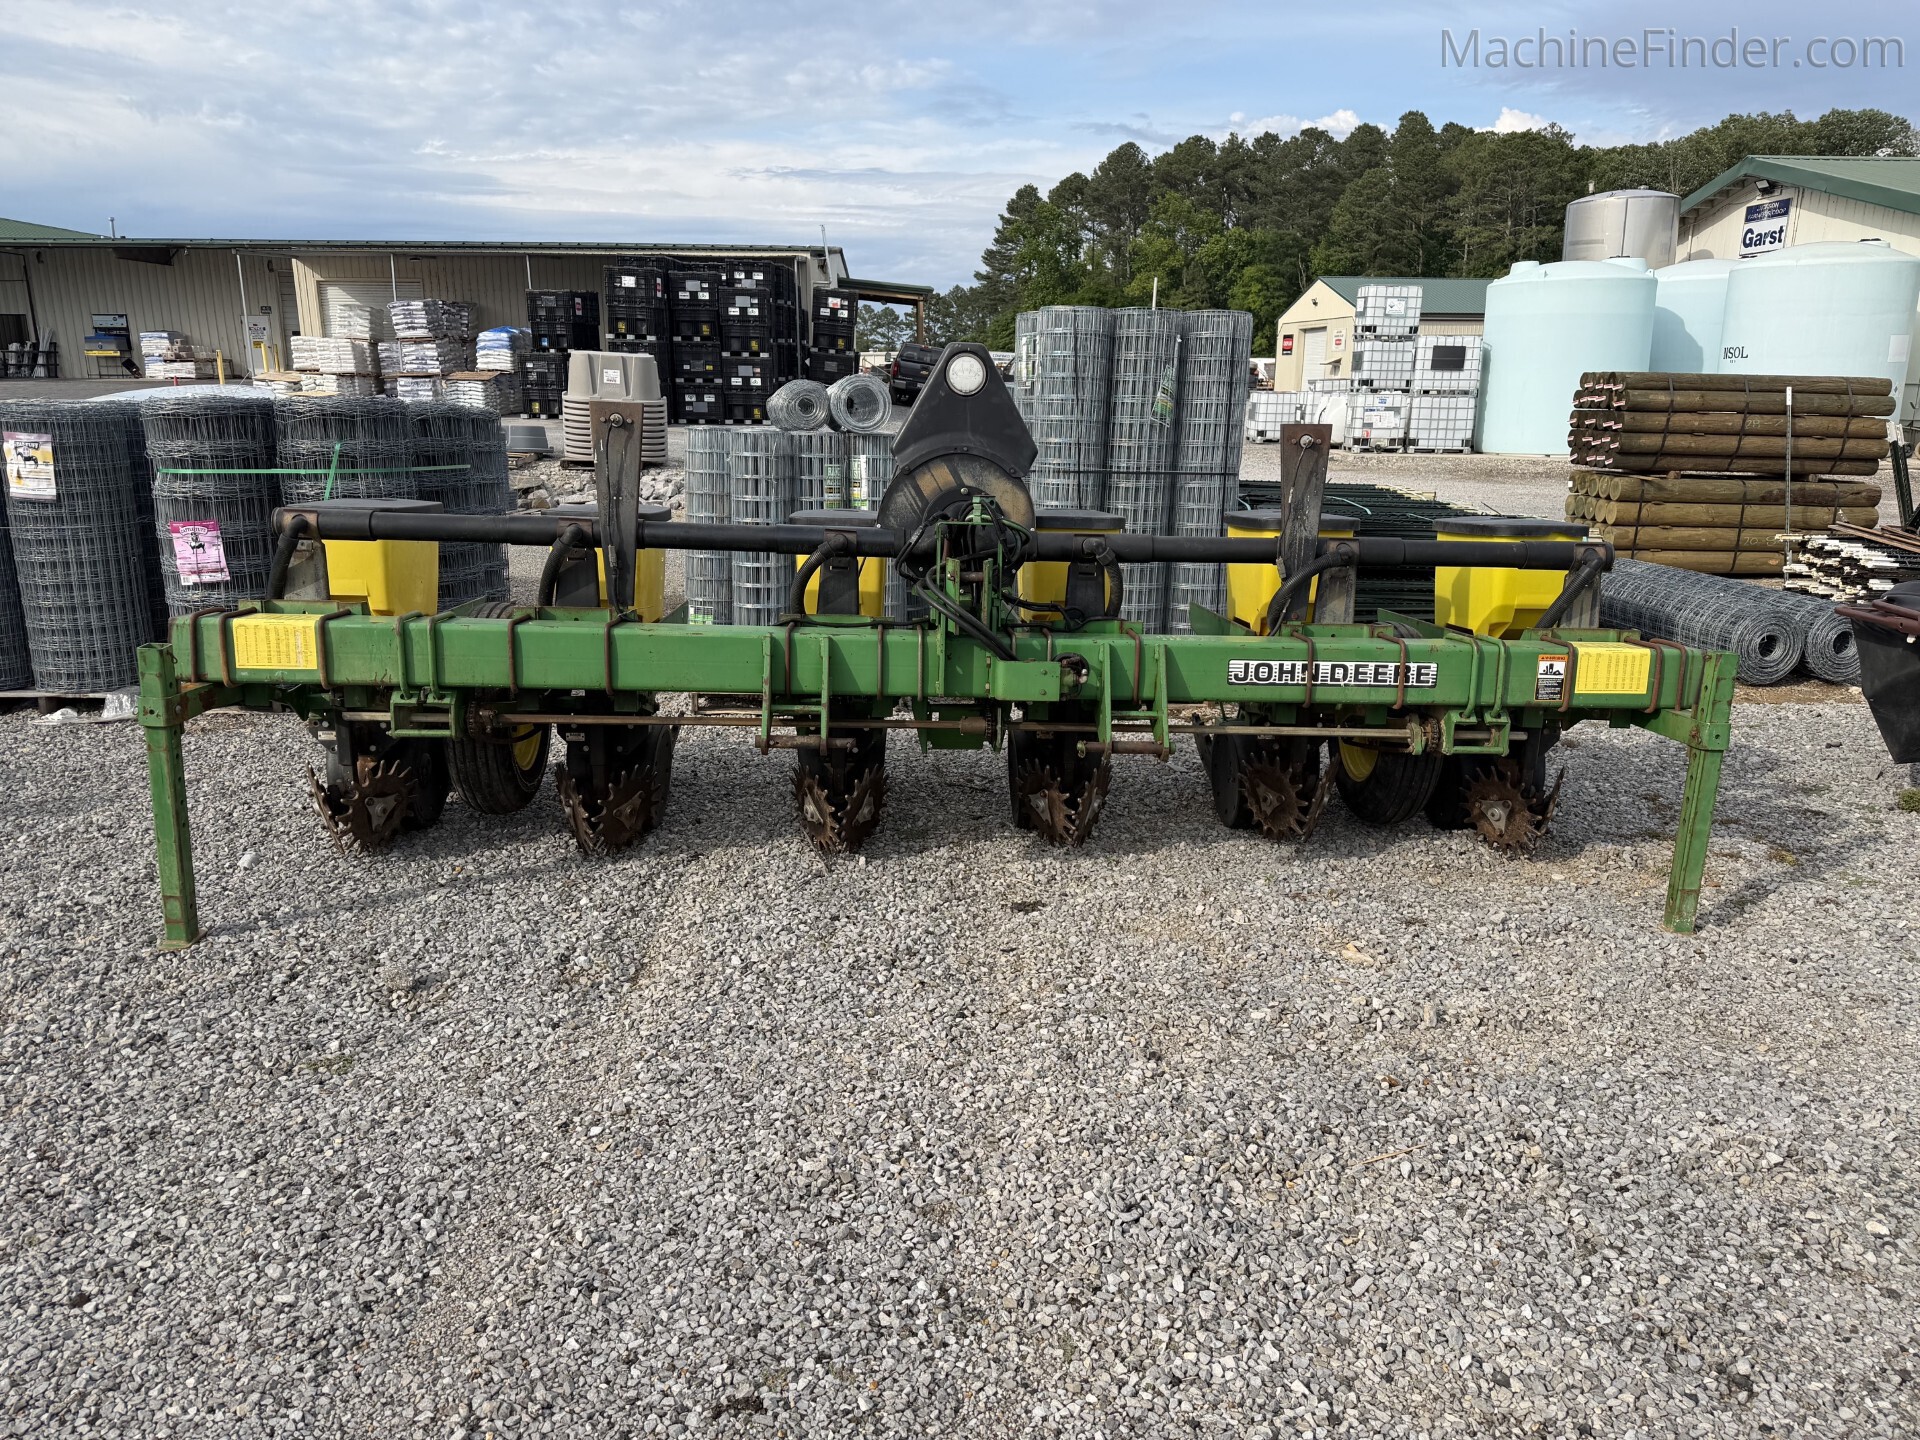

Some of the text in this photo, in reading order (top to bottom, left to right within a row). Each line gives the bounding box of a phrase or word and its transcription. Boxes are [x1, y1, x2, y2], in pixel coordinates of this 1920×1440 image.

[1743, 225, 1784, 248] Garst
[1722, 346, 1749, 360] NSOL
[1233, 662, 1432, 685] JOHN DEERE
